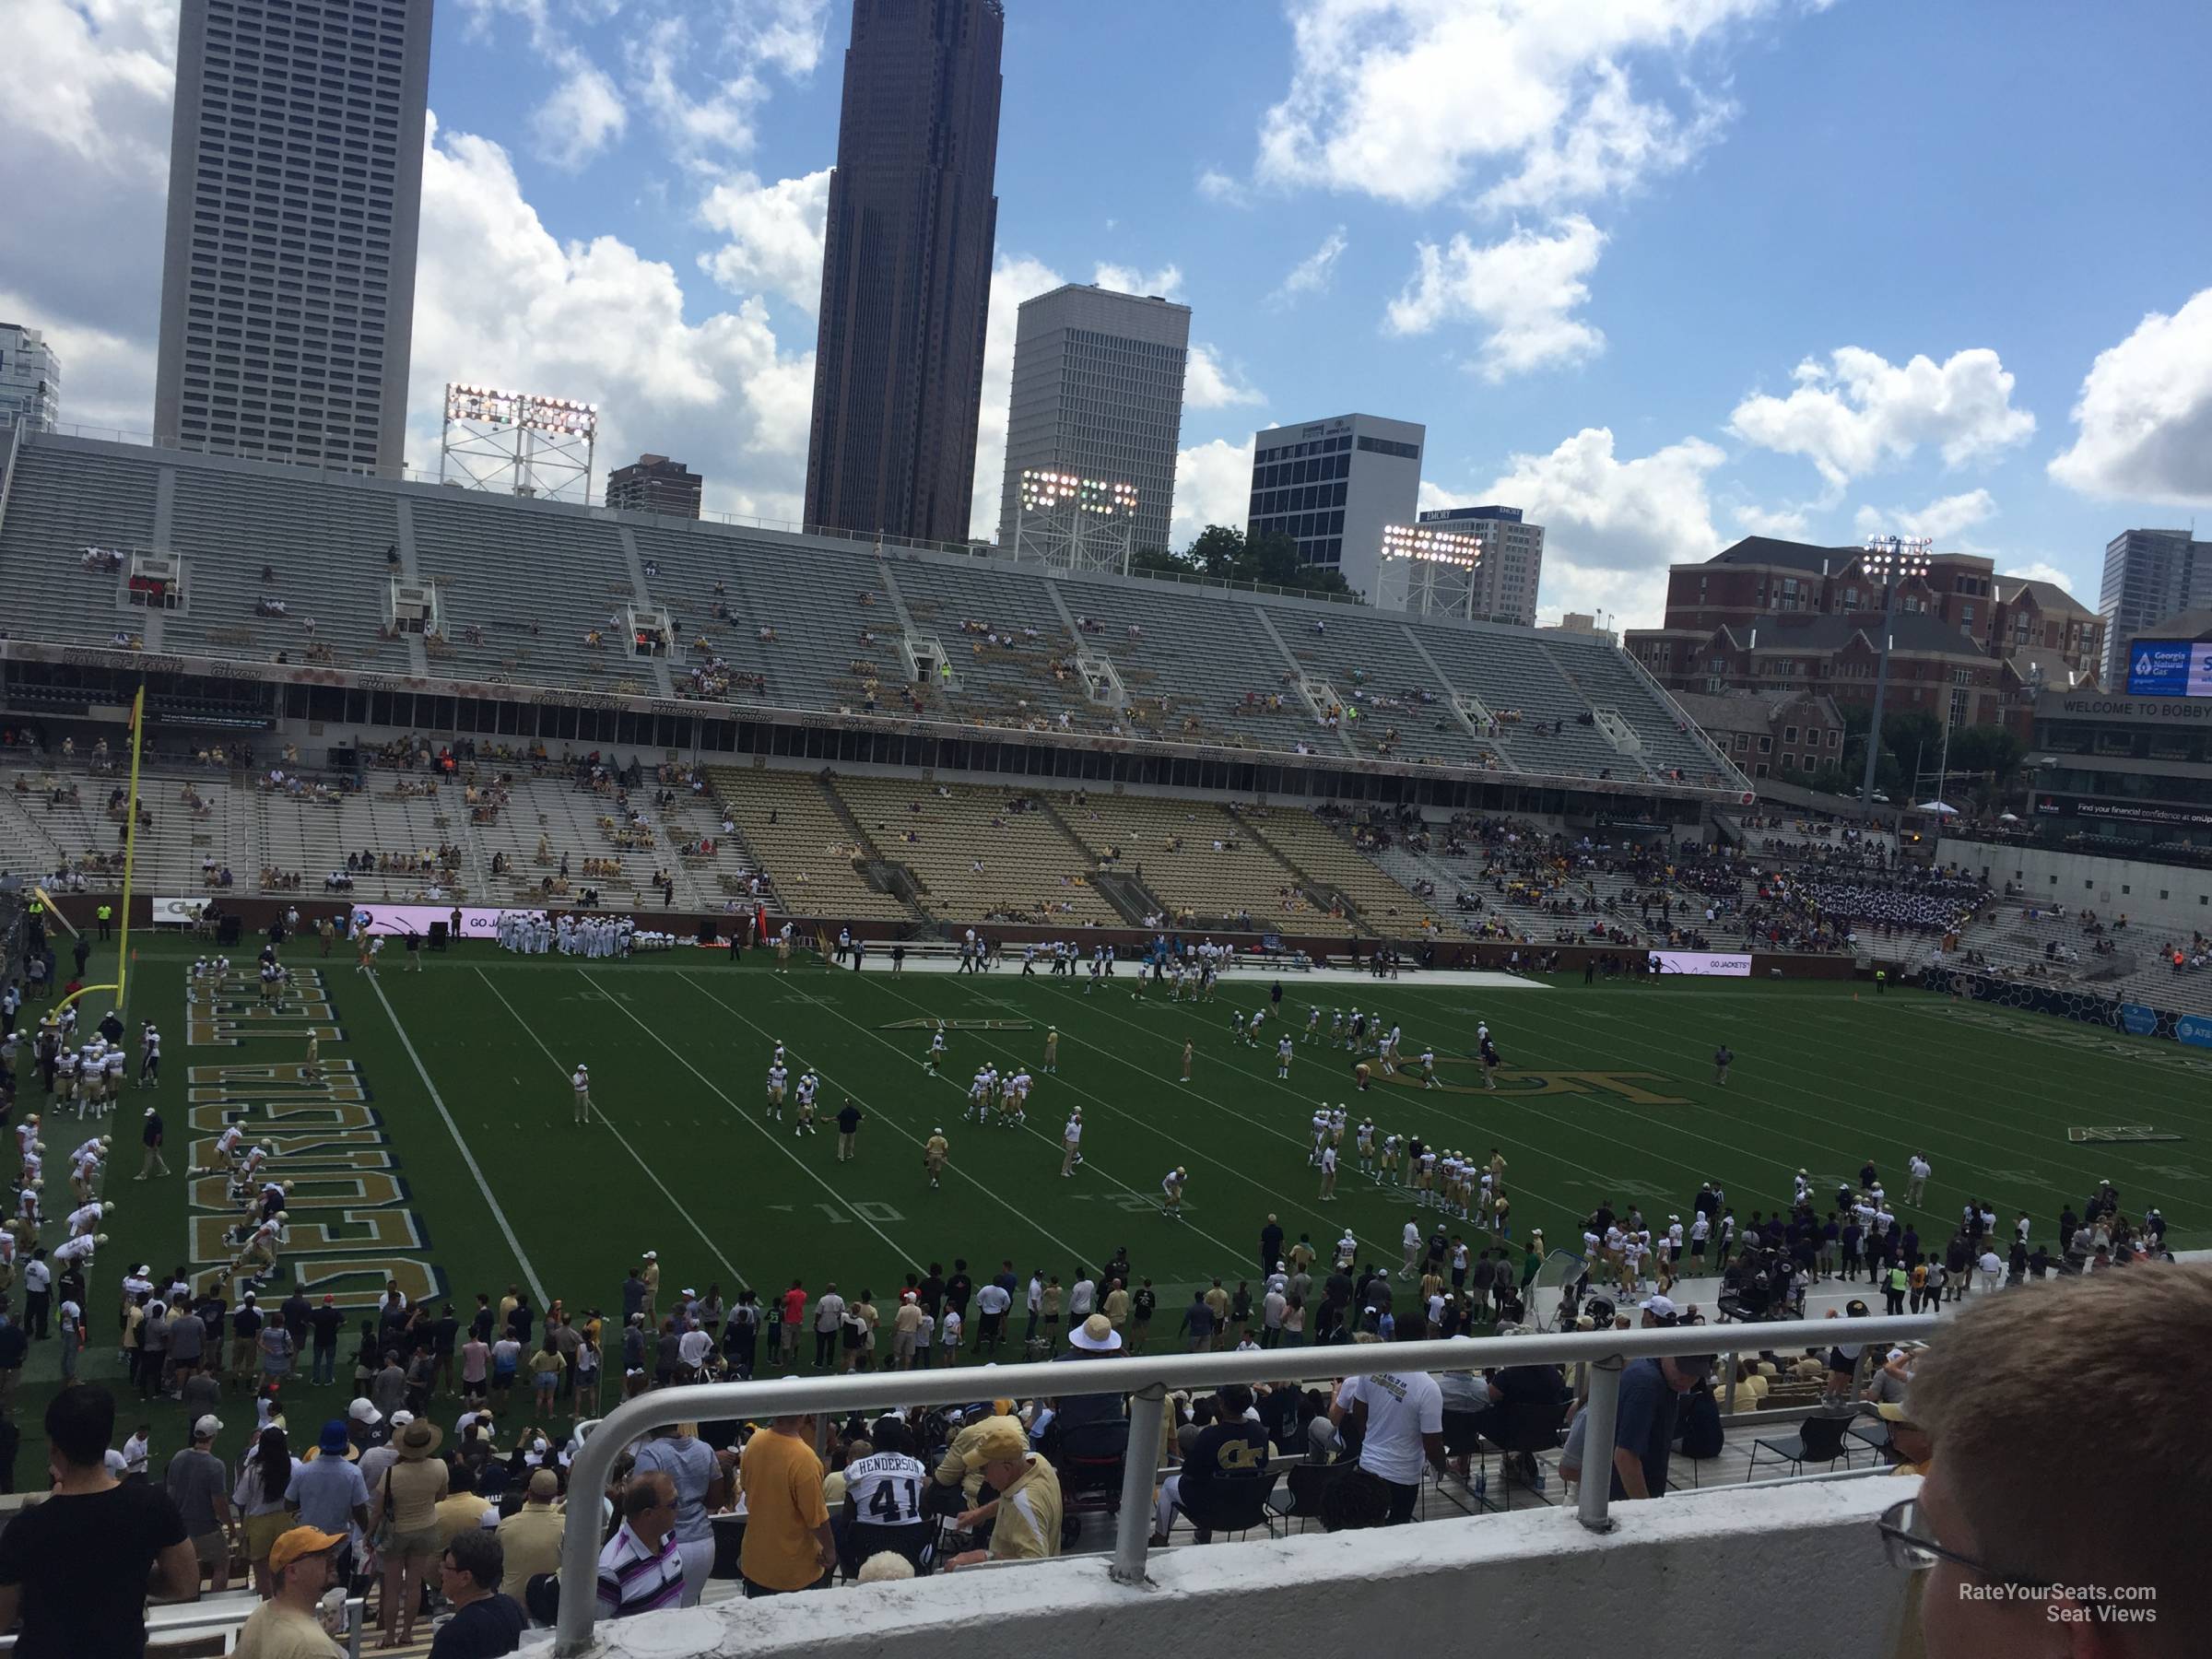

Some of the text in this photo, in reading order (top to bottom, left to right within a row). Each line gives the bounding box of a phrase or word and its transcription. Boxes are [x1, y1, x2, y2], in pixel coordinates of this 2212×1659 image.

[1427, 510, 1451, 520] EMORY
[63, 653, 184, 673] HALL OF FAME
[64, 647, 183, 663] PROFESSIONAL FOOTBALL
[2154, 652, 2185, 661] Georgia
[2153, 660, 2183, 668] Natural
[211, 667, 261, 680] GUYON
[359, 679, 398, 690] SHAW
[531, 694, 630, 711] HALL OF FAME
[2064, 700, 2212, 717] WELCOME TO BOBBY
[651, 706, 707, 717] BAUGHAN
[729, 713, 773, 723] MORRIS
[2077, 803, 2094, 811] Find
[2094, 806, 2111, 814] your
[2112, 806, 2140, 816] financial
[2142, 810, 2181, 820] confidence
[470, 918, 487, 927] GO
[187, 1058, 441, 1314] GEORGIA
[813, 1201, 906, 1224] 10
[858, 1457, 920, 1476] HENDERSON
[869, 1478, 918, 1523] 41
